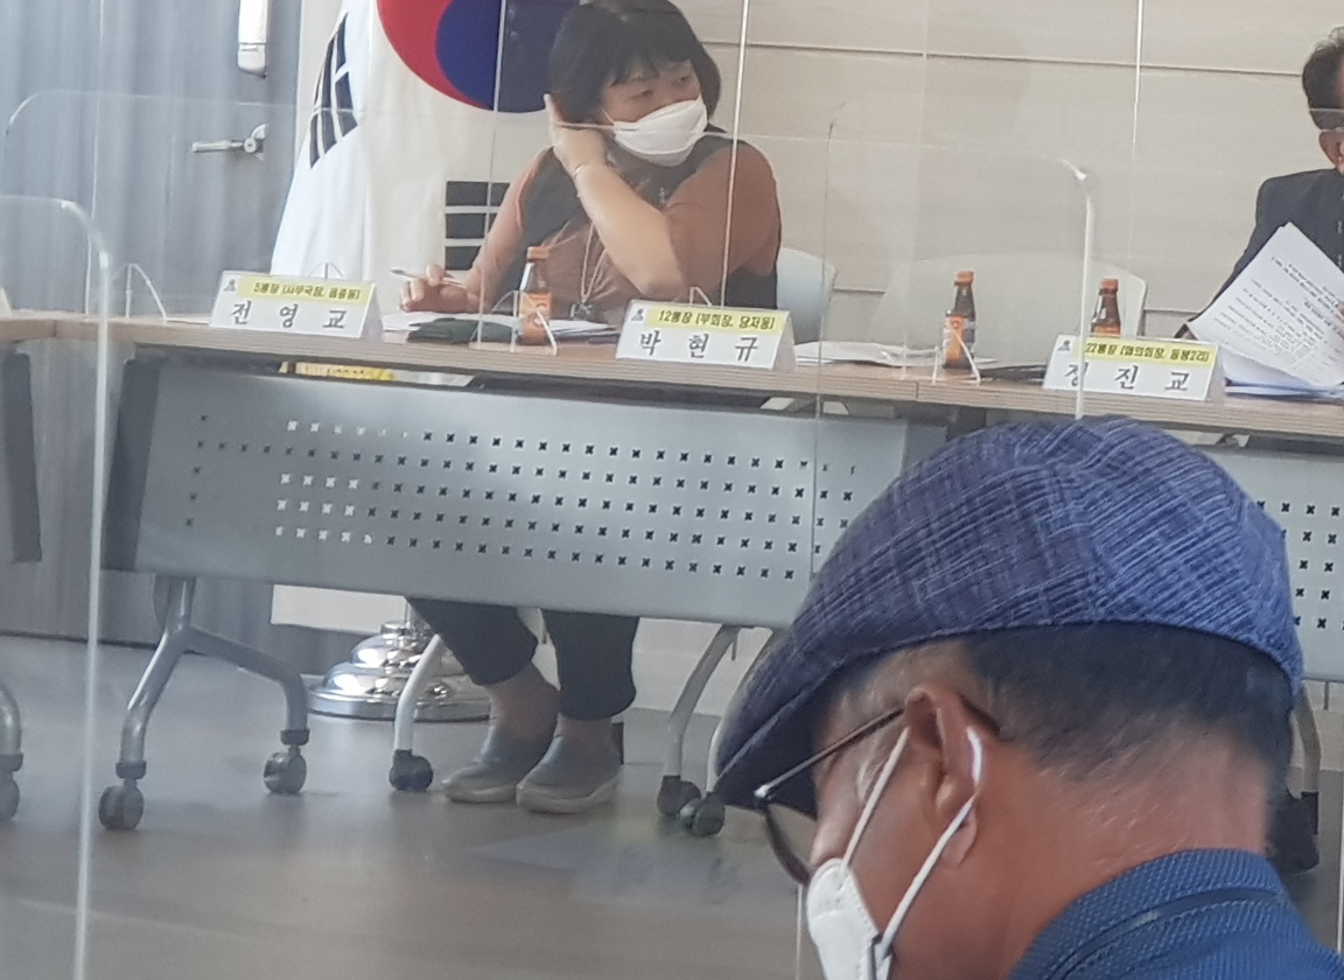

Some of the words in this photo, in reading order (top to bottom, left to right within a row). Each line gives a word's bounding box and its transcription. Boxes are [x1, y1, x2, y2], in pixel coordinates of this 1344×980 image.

[279, 304, 298, 328] 영
[323, 310, 347, 329] 교
[640, 330, 661, 356] 박
[735, 336, 758, 362] 규
[1114, 364, 1139, 390] 진
[1164, 371, 1190, 391] 교
